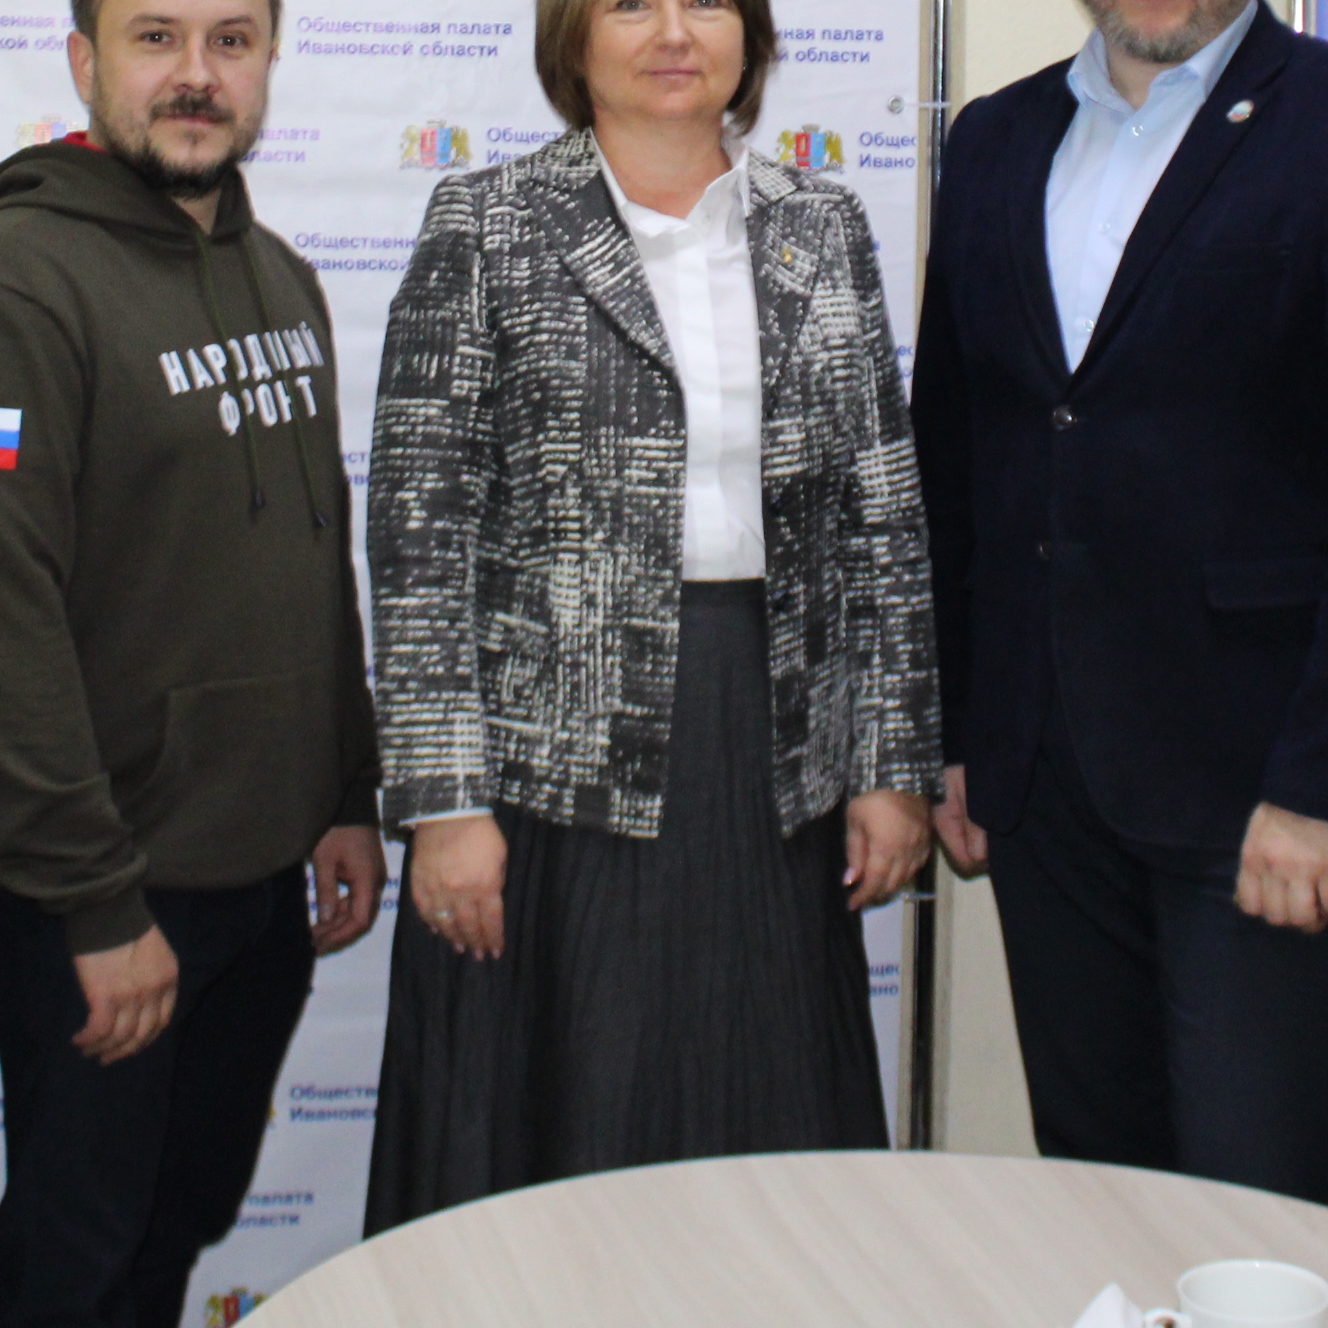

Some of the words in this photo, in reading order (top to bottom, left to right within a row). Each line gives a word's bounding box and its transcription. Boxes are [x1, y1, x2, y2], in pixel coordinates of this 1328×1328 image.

[297, 16, 442, 34] Общественная
[447, 23, 513, 36] палата
[821, 29, 886, 43] палата
[296, 40, 414, 56] Ивановской
[420, 41, 499, 58] области
[794, 47, 871, 64] области
[296, 233, 417, 250] Общественн
